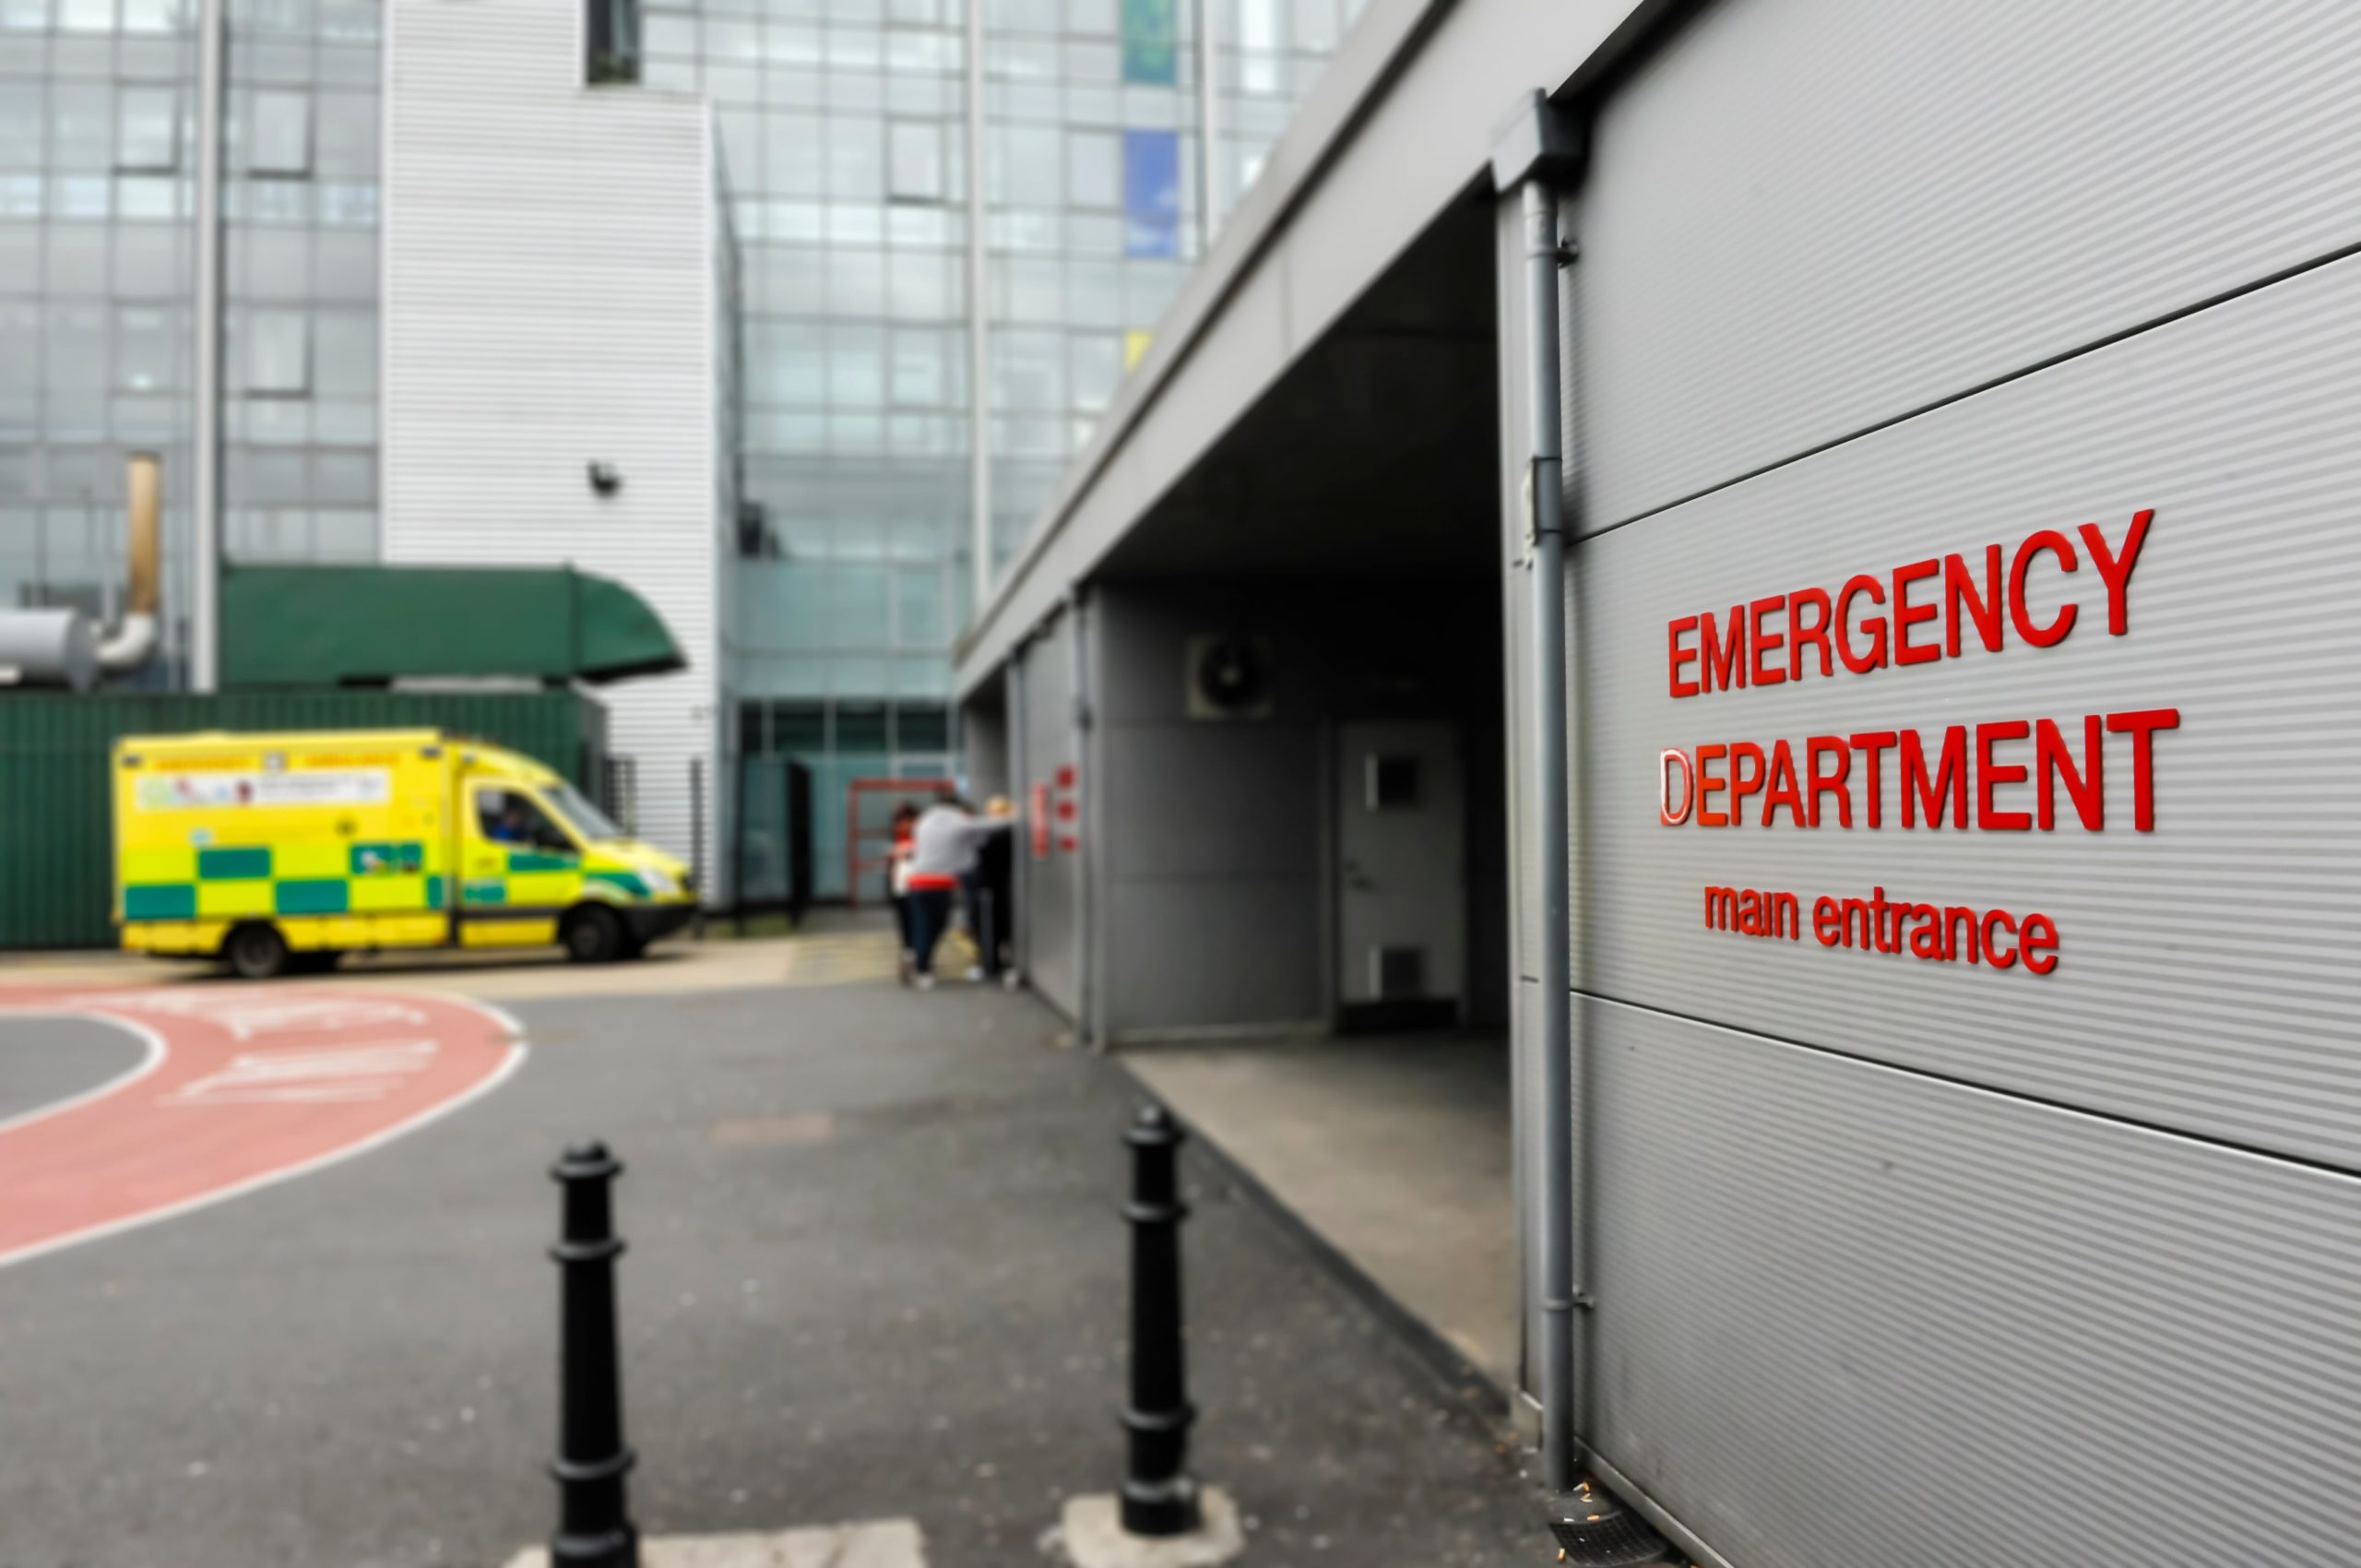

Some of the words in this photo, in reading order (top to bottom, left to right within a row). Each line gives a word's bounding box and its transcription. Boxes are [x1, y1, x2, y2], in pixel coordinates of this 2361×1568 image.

[1667, 508, 2154, 699] EMERGENCY
[1659, 707, 2180, 832] DEPARTMENT
[1703, 885, 1799, 941] main
[1812, 885, 2059, 974] entrance
